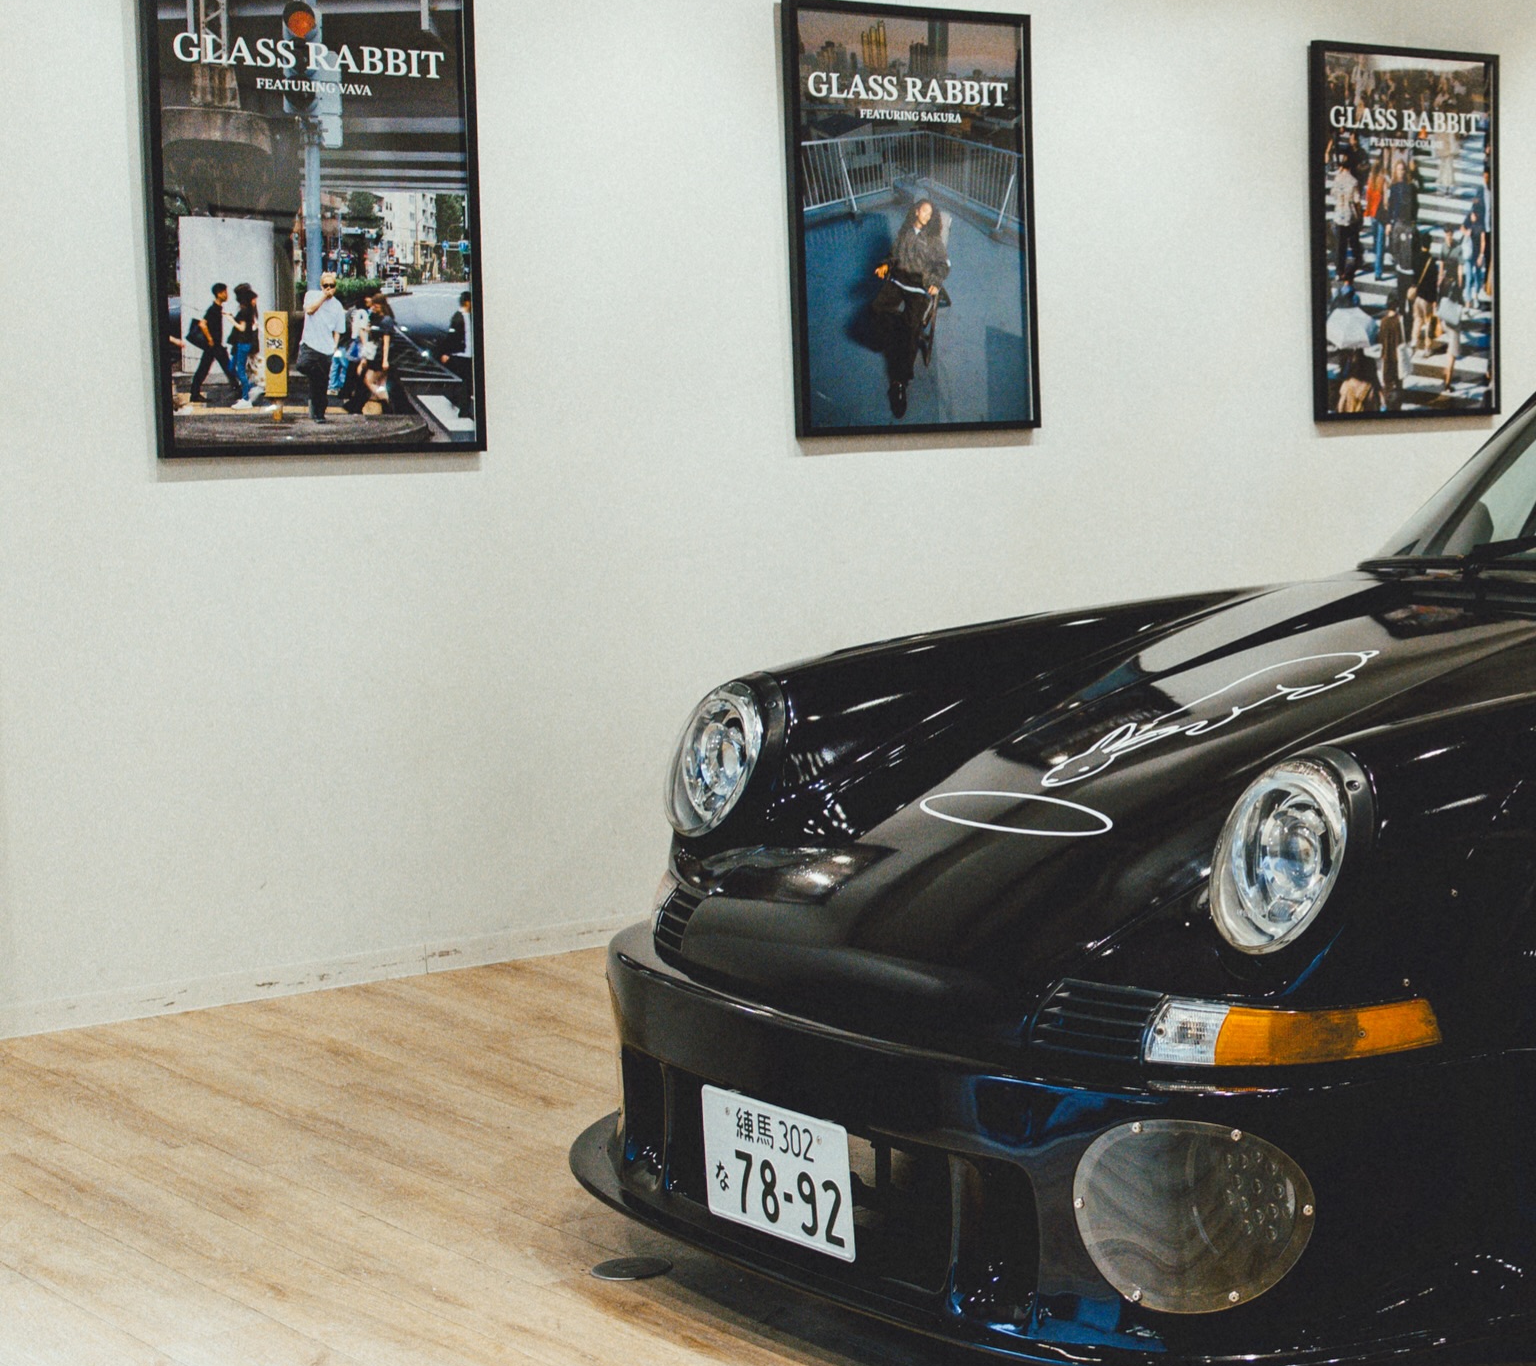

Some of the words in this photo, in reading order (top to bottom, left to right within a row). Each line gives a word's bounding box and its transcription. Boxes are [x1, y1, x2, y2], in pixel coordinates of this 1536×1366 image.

[172, 32, 297, 69] GLASS
[306, 41, 445, 79] RABBIT
[256, 77, 336, 94] FEATURING
[338, 84, 373, 97] VAVA
[807, 71, 899, 101] GLASS
[904, 77, 1009, 107] RABBIT
[859, 109, 920, 122] FEATURING
[920, 111, 963, 124] SAKURA
[1329, 105, 1398, 131] GLASS
[1402, 110, 1481, 135] RABBIT
[1370, 136, 1415, 148] FEATURING
[735, 1107, 775, 1150] 練馬
[778, 1120, 815, 1164] 302
[715, 1160, 730, 1192] な
[734, 1148, 846, 1249] 78-92
